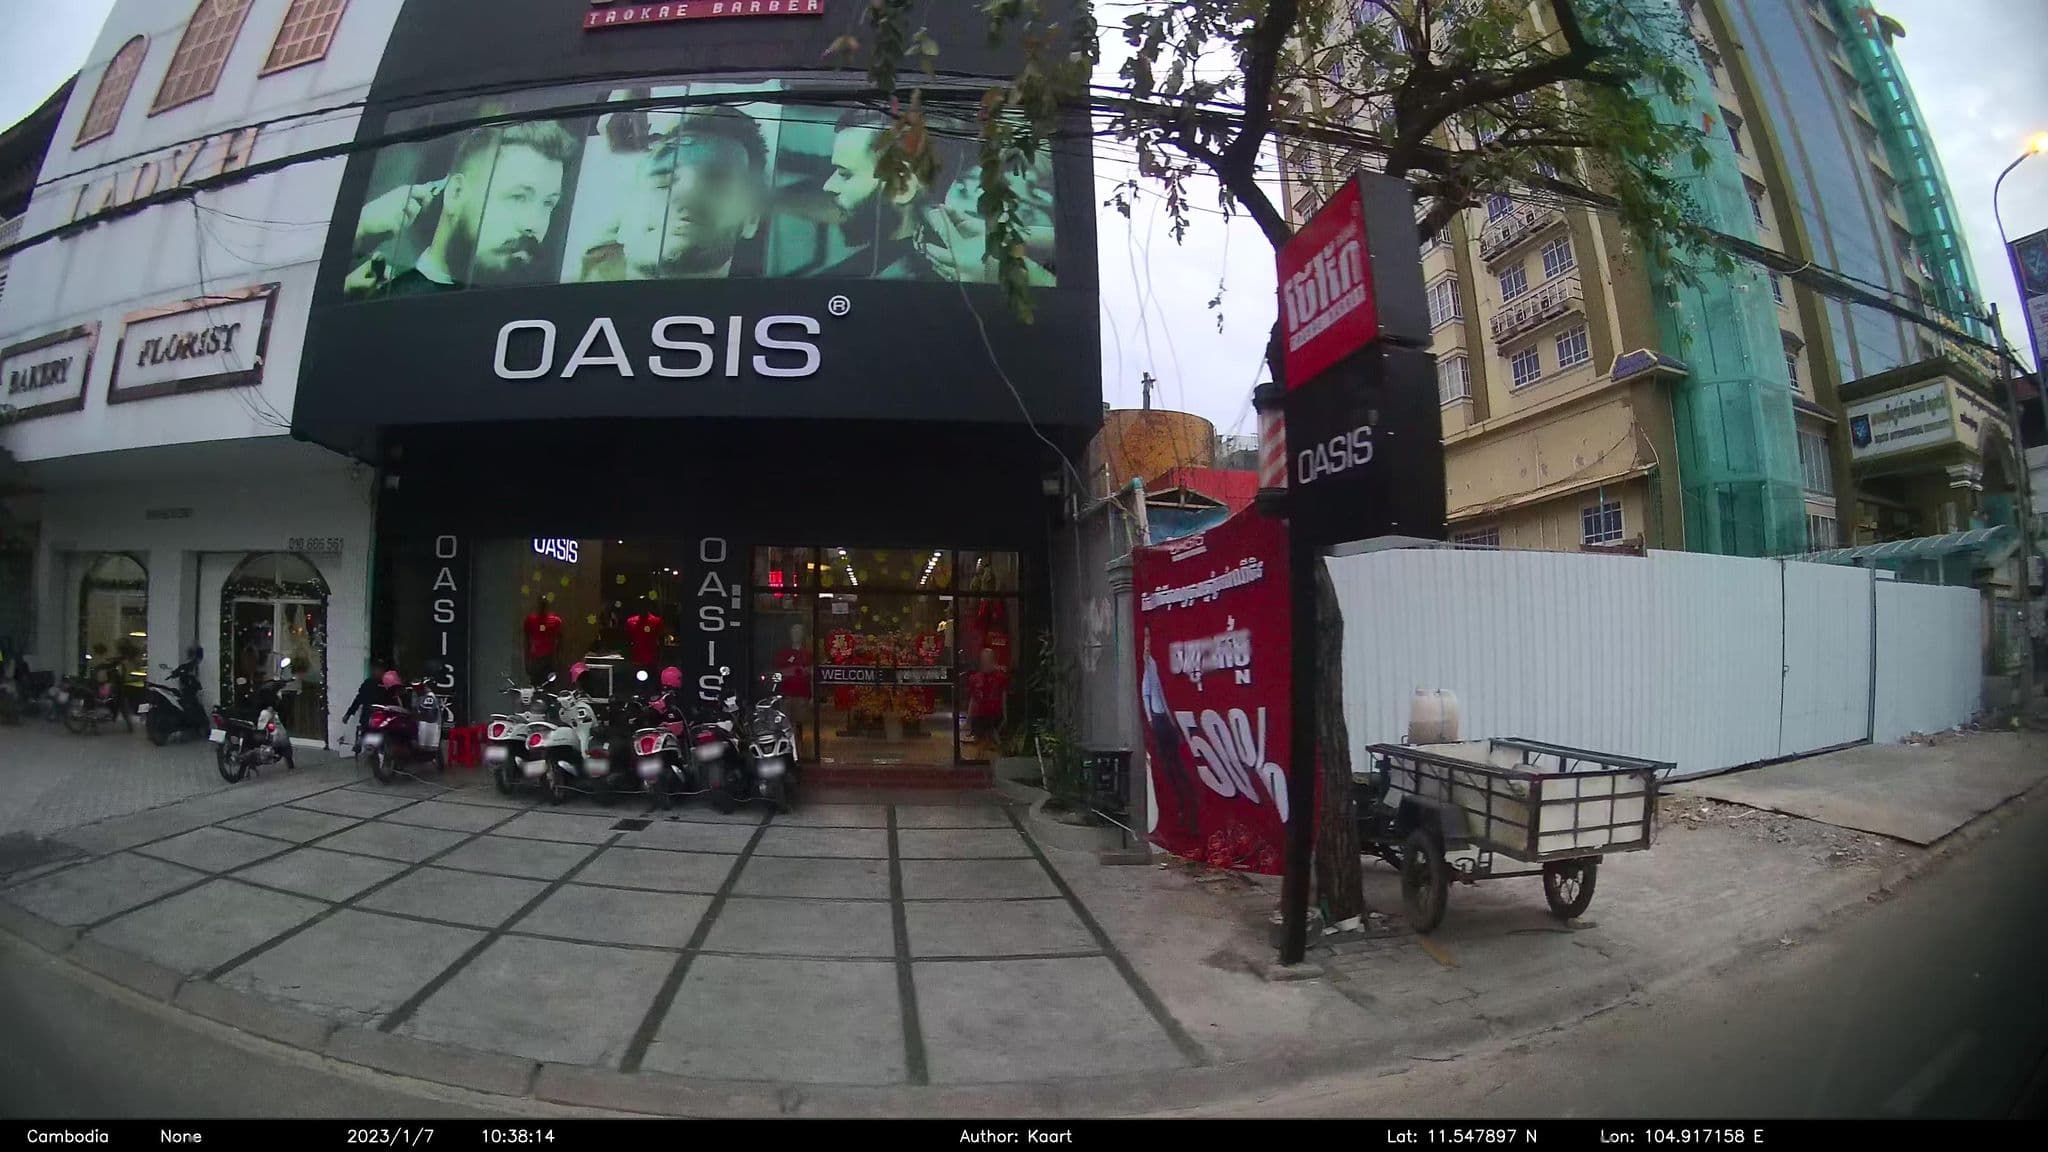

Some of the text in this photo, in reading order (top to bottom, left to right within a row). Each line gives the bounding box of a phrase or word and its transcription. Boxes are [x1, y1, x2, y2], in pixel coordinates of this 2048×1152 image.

[589, 0, 819, 25] TAOKAE BARBER
[137, 322, 242, 368] FLORIST
[494, 315, 822, 380] OASIS
[1298, 426, 1374, 486] OASIS
[533, 538, 579, 564] OASIS
[698, 537, 728, 700] OASIS
[1175, 706, 1290, 824] 50%
